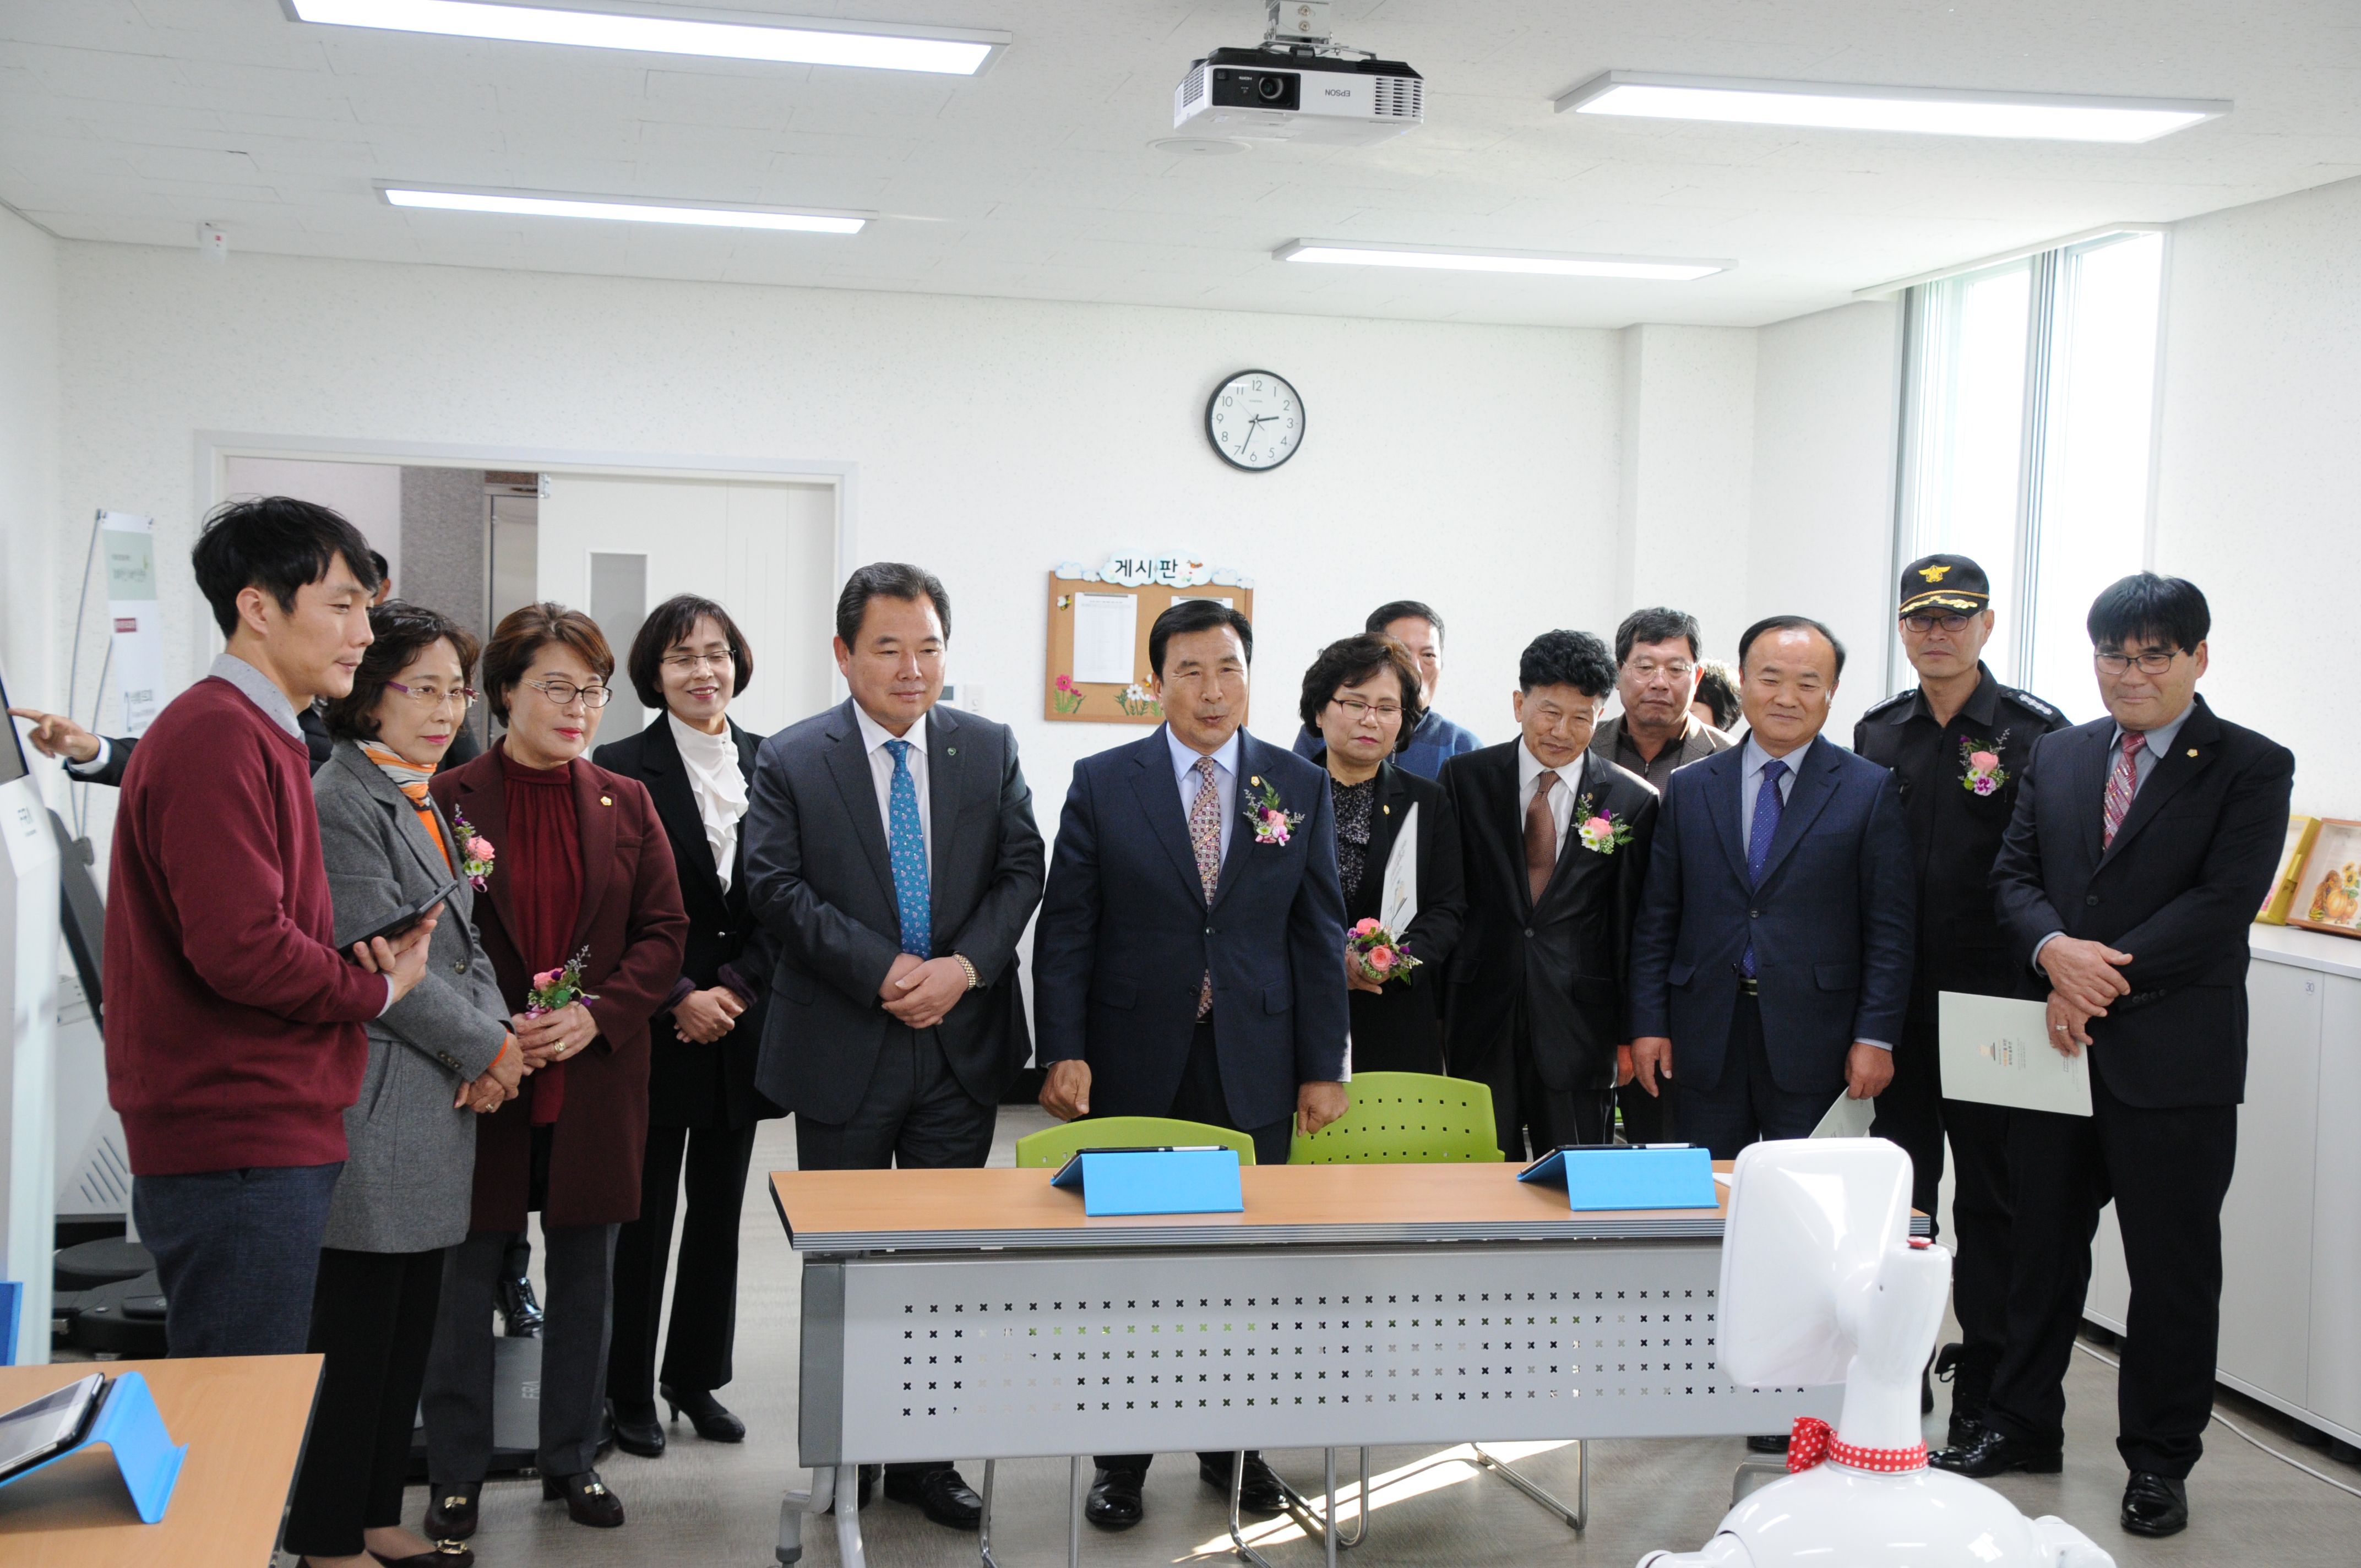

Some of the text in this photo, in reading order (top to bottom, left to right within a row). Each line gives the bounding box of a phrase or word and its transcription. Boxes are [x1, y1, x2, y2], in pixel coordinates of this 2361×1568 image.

[1325, 89, 1351, 97] EPSON
[1236, 385, 1244, 395] 11
[1252, 380, 1263, 391] 12
[1222, 396, 1233, 407] 10
[1283, 400, 1290, 411] 2
[1216, 413, 1224, 424] 9
[1286, 417, 1294, 429] 3
[1221, 431, 1229, 442] 8
[1280, 435, 1287, 446] 4
[1234, 445, 1242, 456] 7
[1267, 447, 1275, 458] 5
[1249, 451, 1258, 462] 6
[1114, 558, 1178, 579] 게시판
